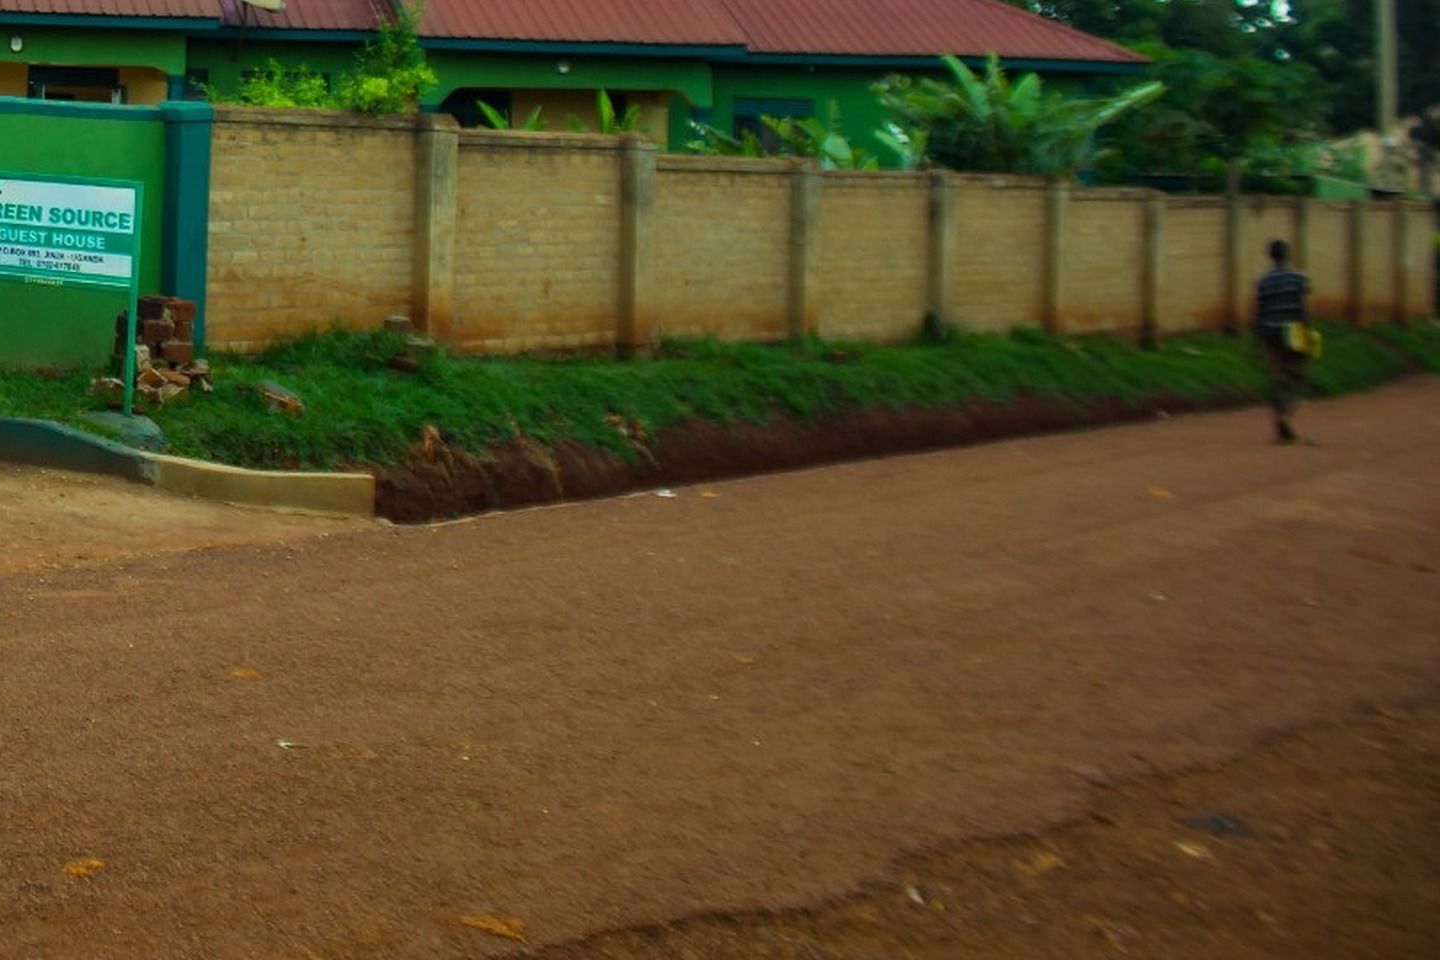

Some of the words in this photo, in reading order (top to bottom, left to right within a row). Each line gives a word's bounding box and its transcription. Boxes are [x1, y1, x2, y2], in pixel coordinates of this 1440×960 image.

[49, 207, 131, 230] SOURCE
[53, 233, 106, 250] HOUSE
[70, 252, 105, 263] UGANDA
